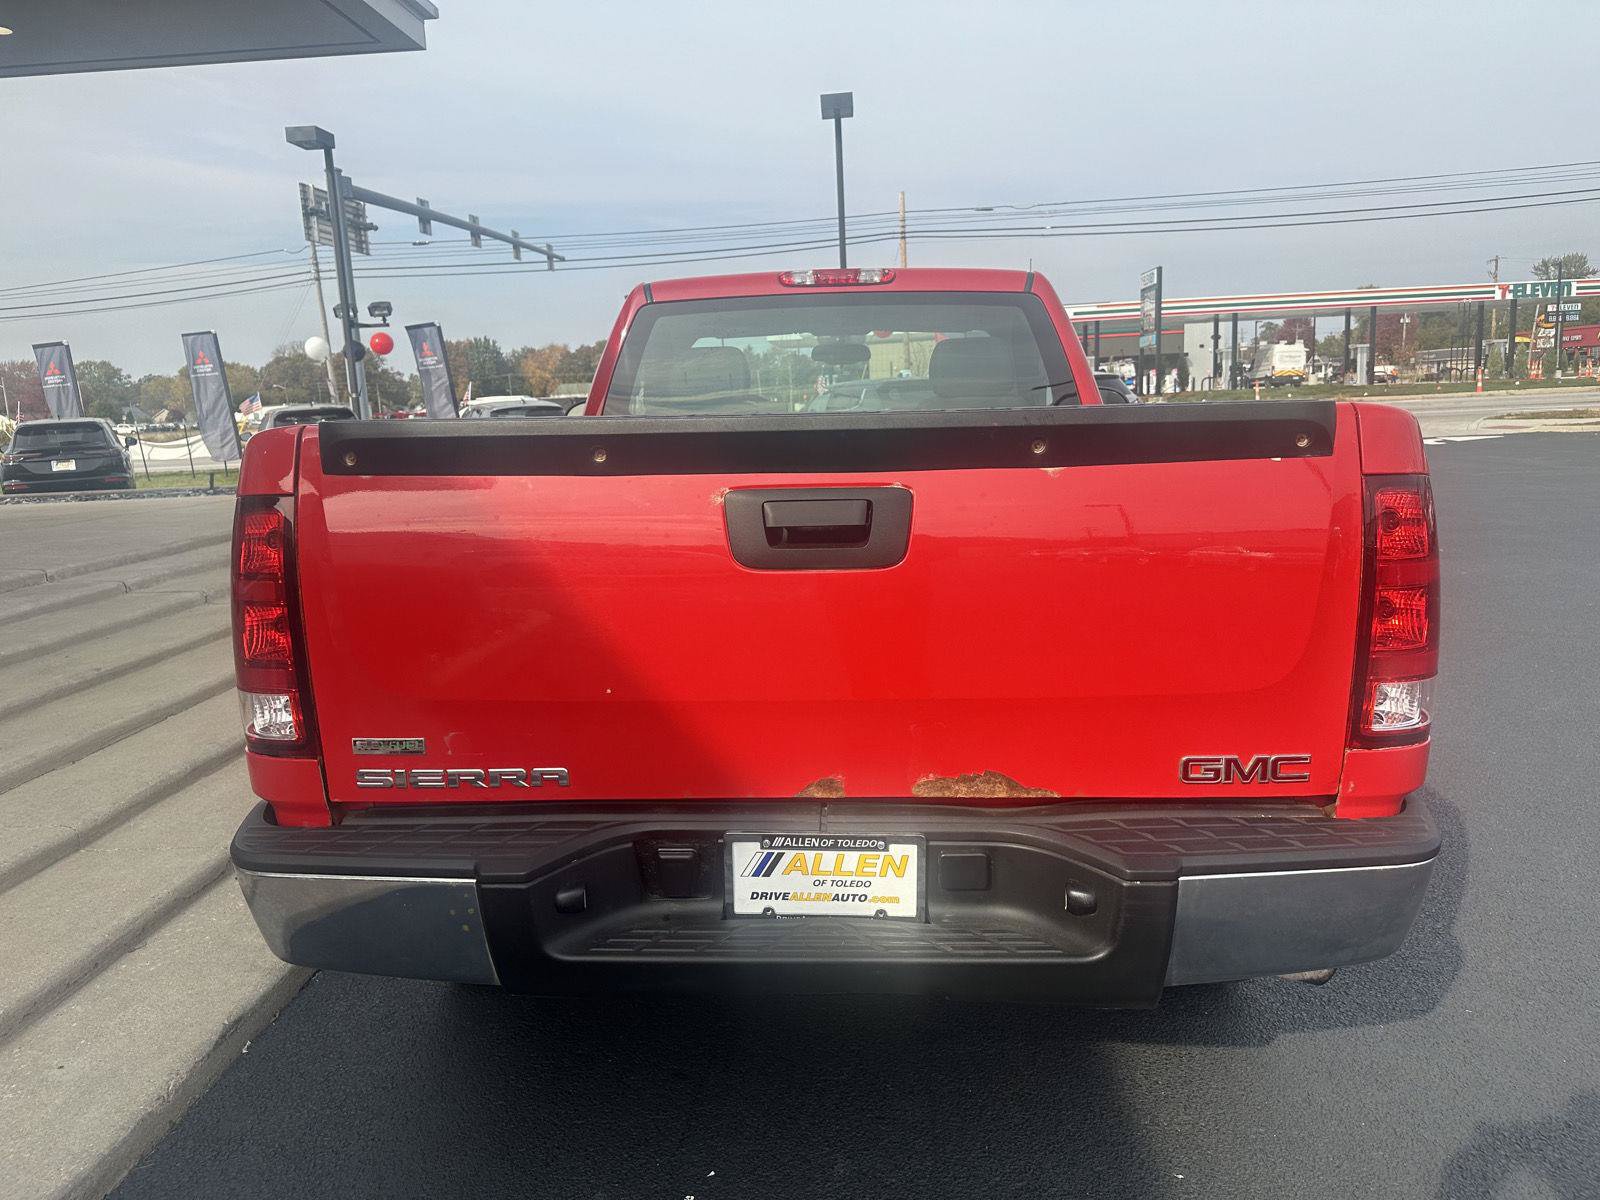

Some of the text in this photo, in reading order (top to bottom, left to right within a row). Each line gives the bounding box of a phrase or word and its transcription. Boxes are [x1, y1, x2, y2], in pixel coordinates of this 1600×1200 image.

[1179, 754, 1312, 784] GMC
[356, 768, 570, 788] SIERRA
[783, 837, 878, 848] ALLEN OF TOLEDO
[781, 852, 910, 878] ALLEN
[812, 879, 872, 888] OF TOLEDO
[749, 891, 900, 904] DRIVEALLENAUTO.com
